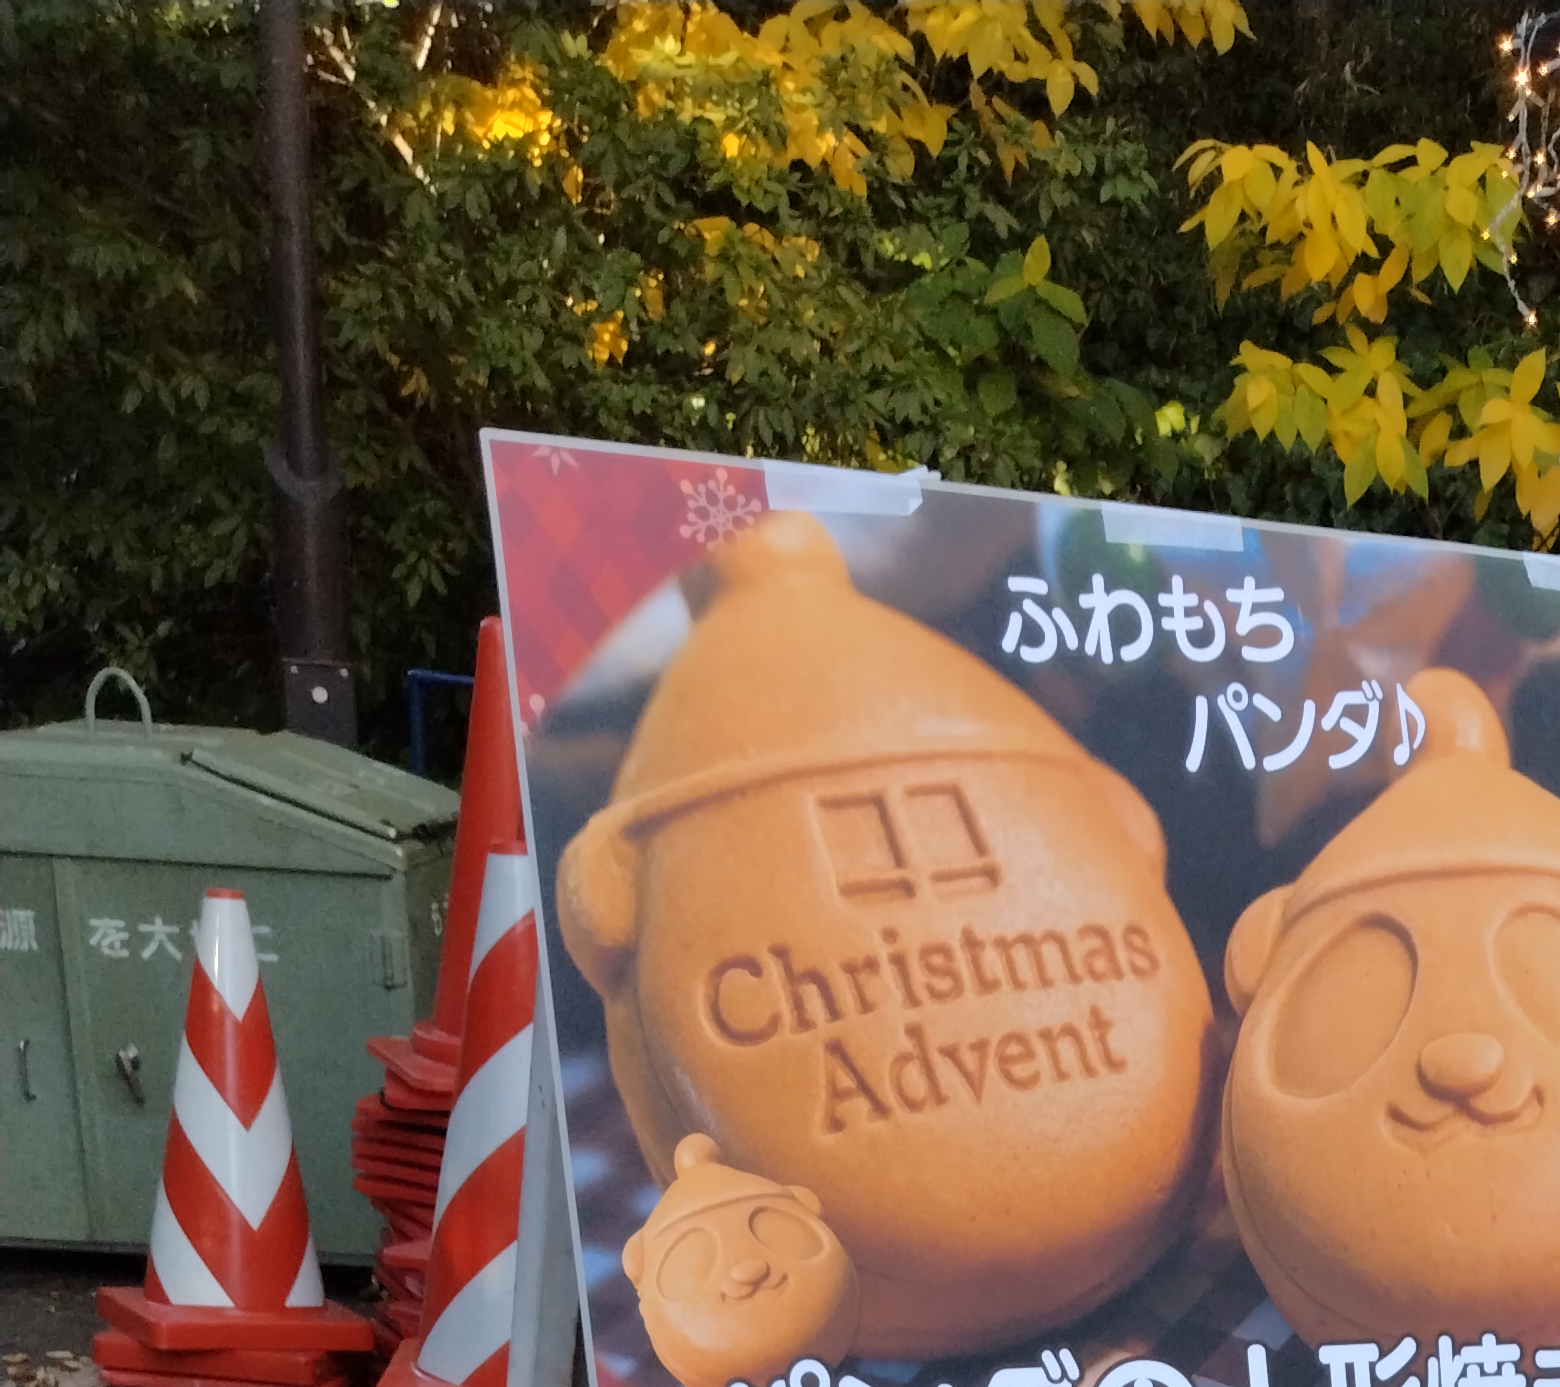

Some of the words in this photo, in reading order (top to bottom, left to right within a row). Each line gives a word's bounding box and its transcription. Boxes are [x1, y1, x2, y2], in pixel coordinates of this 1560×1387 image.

[1001, 573, 1296, 665] ふわもち
[702, 921, 1161, 1047] Christmas
[822, 1003, 1128, 1133] Advent
